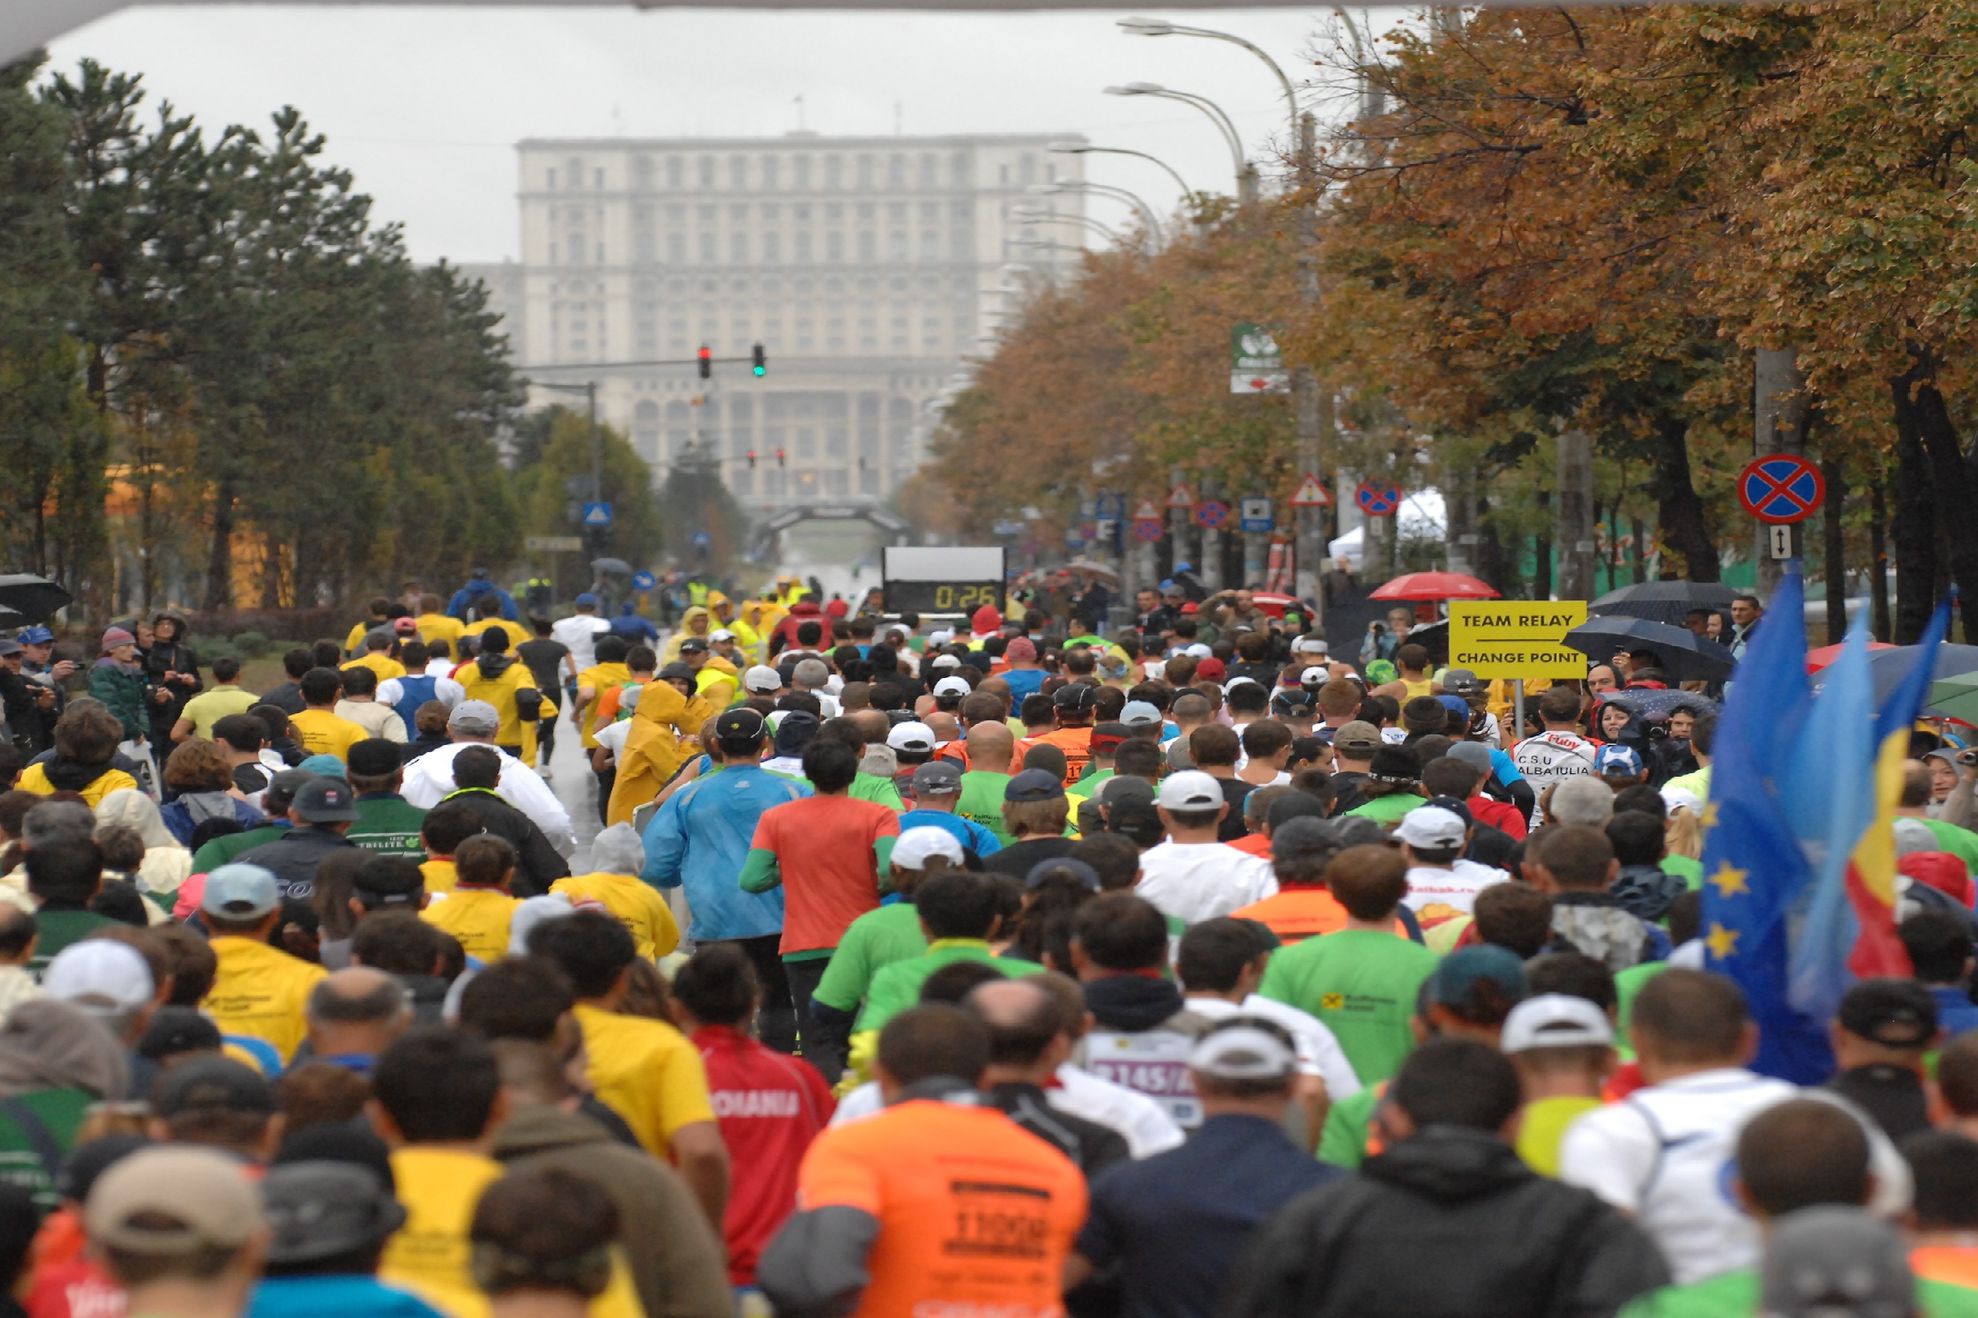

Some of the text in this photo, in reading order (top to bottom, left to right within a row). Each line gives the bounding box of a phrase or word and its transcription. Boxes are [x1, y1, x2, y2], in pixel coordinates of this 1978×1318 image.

[1462, 615, 1573, 627] TEAM RELAY
[1457, 653, 1579, 663] CHANGE POINT
[1518, 767, 1589, 775] ALBA IULIA
